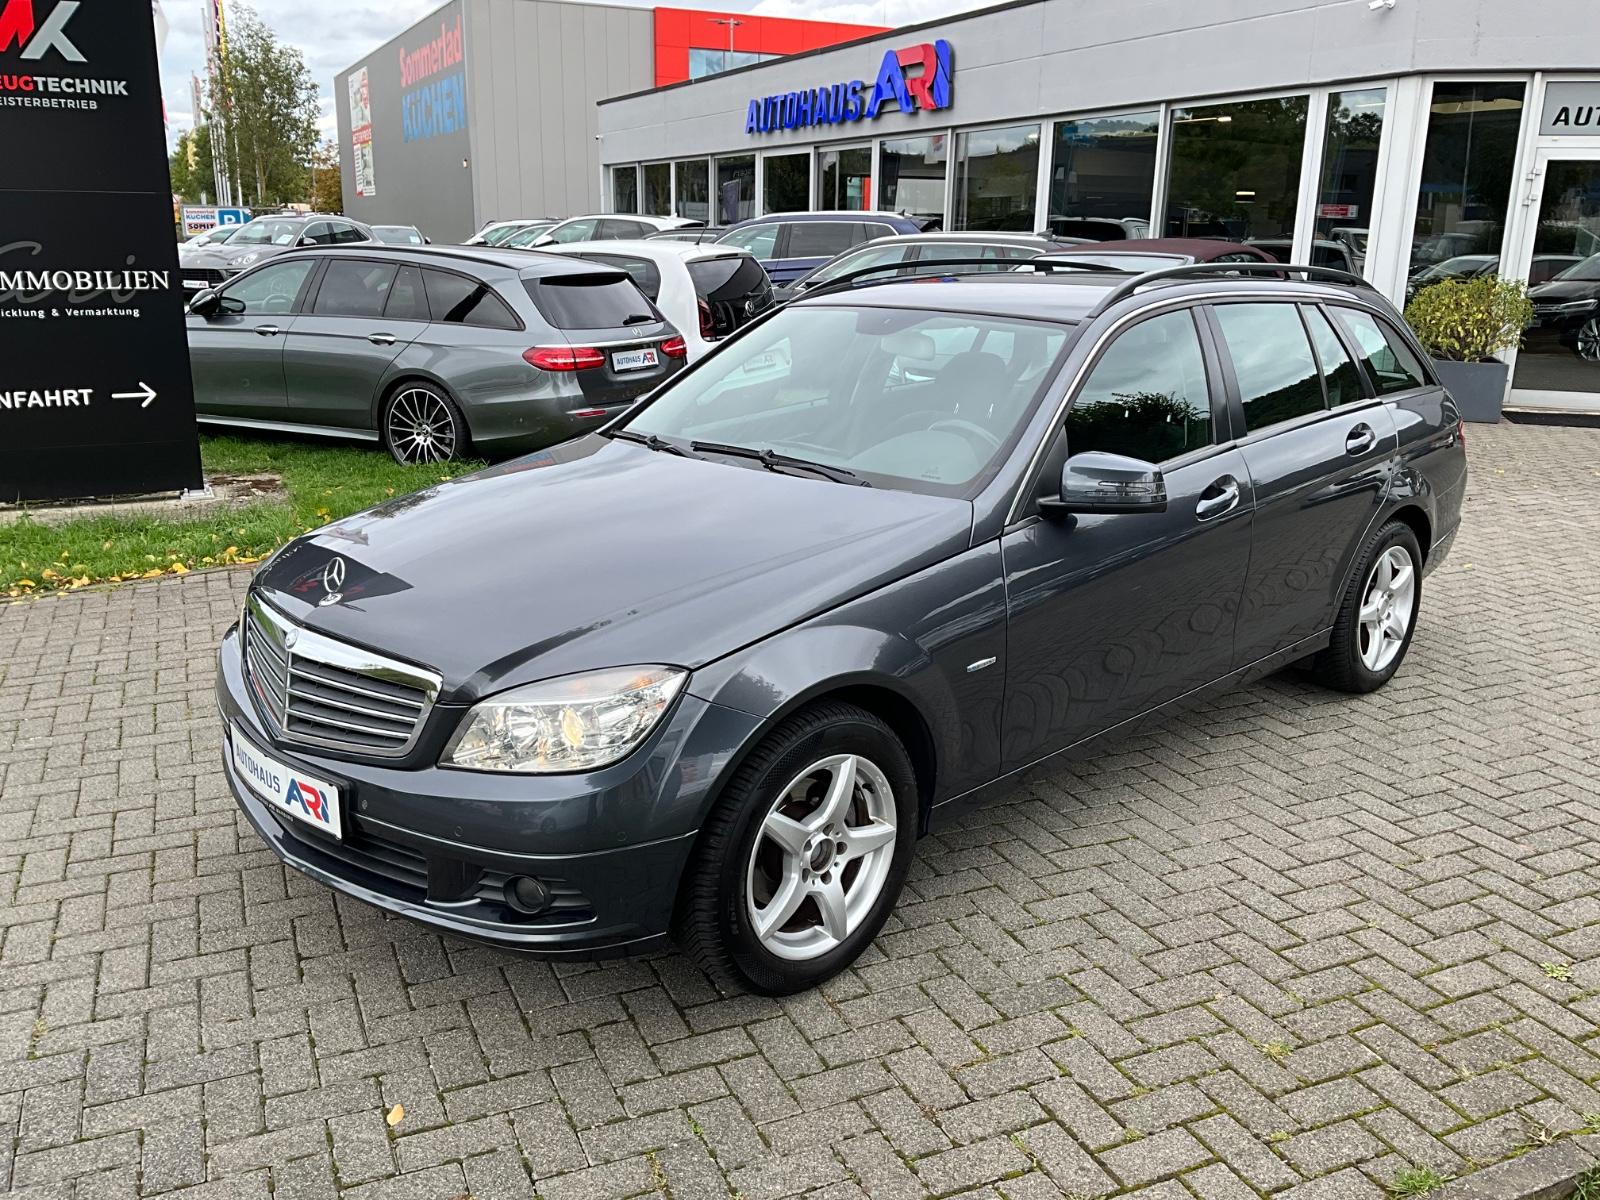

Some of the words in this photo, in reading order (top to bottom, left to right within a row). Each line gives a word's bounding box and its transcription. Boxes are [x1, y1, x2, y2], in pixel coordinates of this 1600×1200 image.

[399, 14, 463, 88] Sommerlad
[745, 80, 866, 134] AUTOHAUS
[865, 39, 954, 118] ARI
[0, 270, 170, 290] MMOBILIEN
[1, 308, 45, 319] icklung
[51, 308, 60, 317] &
[65, 308, 141, 318] Vermarktung
[616, 355, 641, 365] AUTOHAUS
[642, 351, 656, 364] ARI
[0, 388, 94, 409] NFAHRT
[235, 743, 281, 794] AUTOHAUS
[284, 777, 331, 824] ARI
